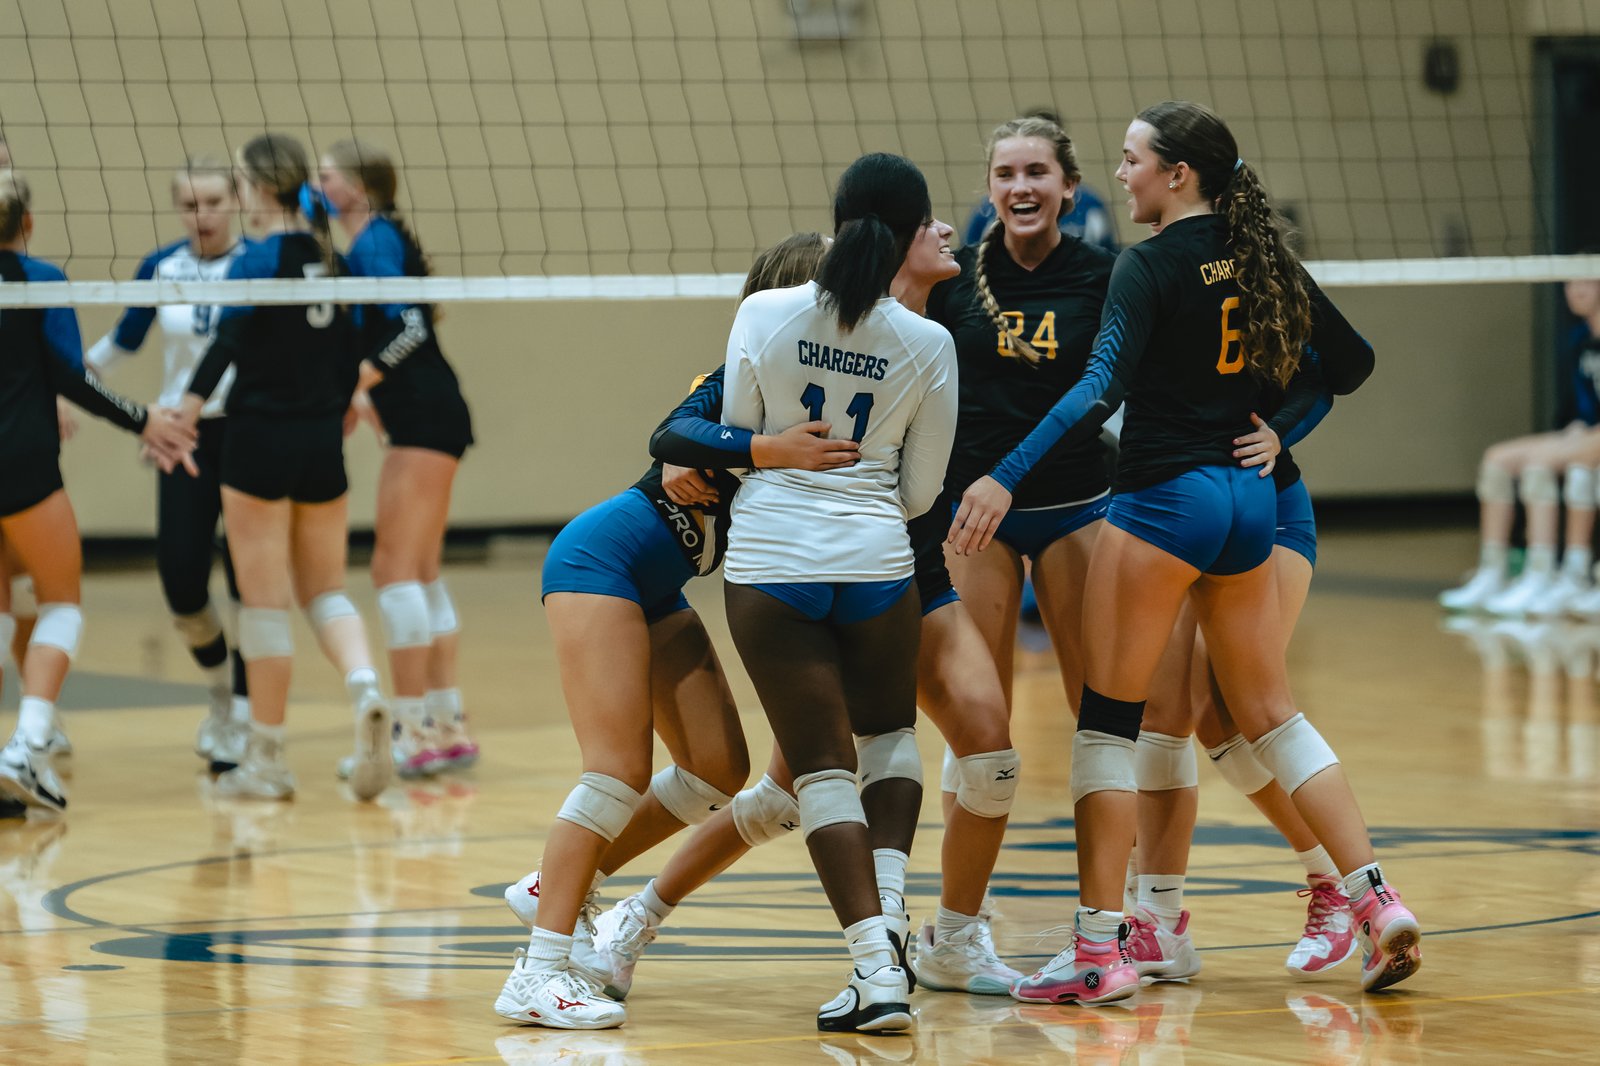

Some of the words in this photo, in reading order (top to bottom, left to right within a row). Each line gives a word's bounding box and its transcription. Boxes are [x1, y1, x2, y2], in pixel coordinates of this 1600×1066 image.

[797, 339, 889, 381] CHARGERS
[1216, 296, 1245, 375] 6
[800, 382, 875, 444] 11
